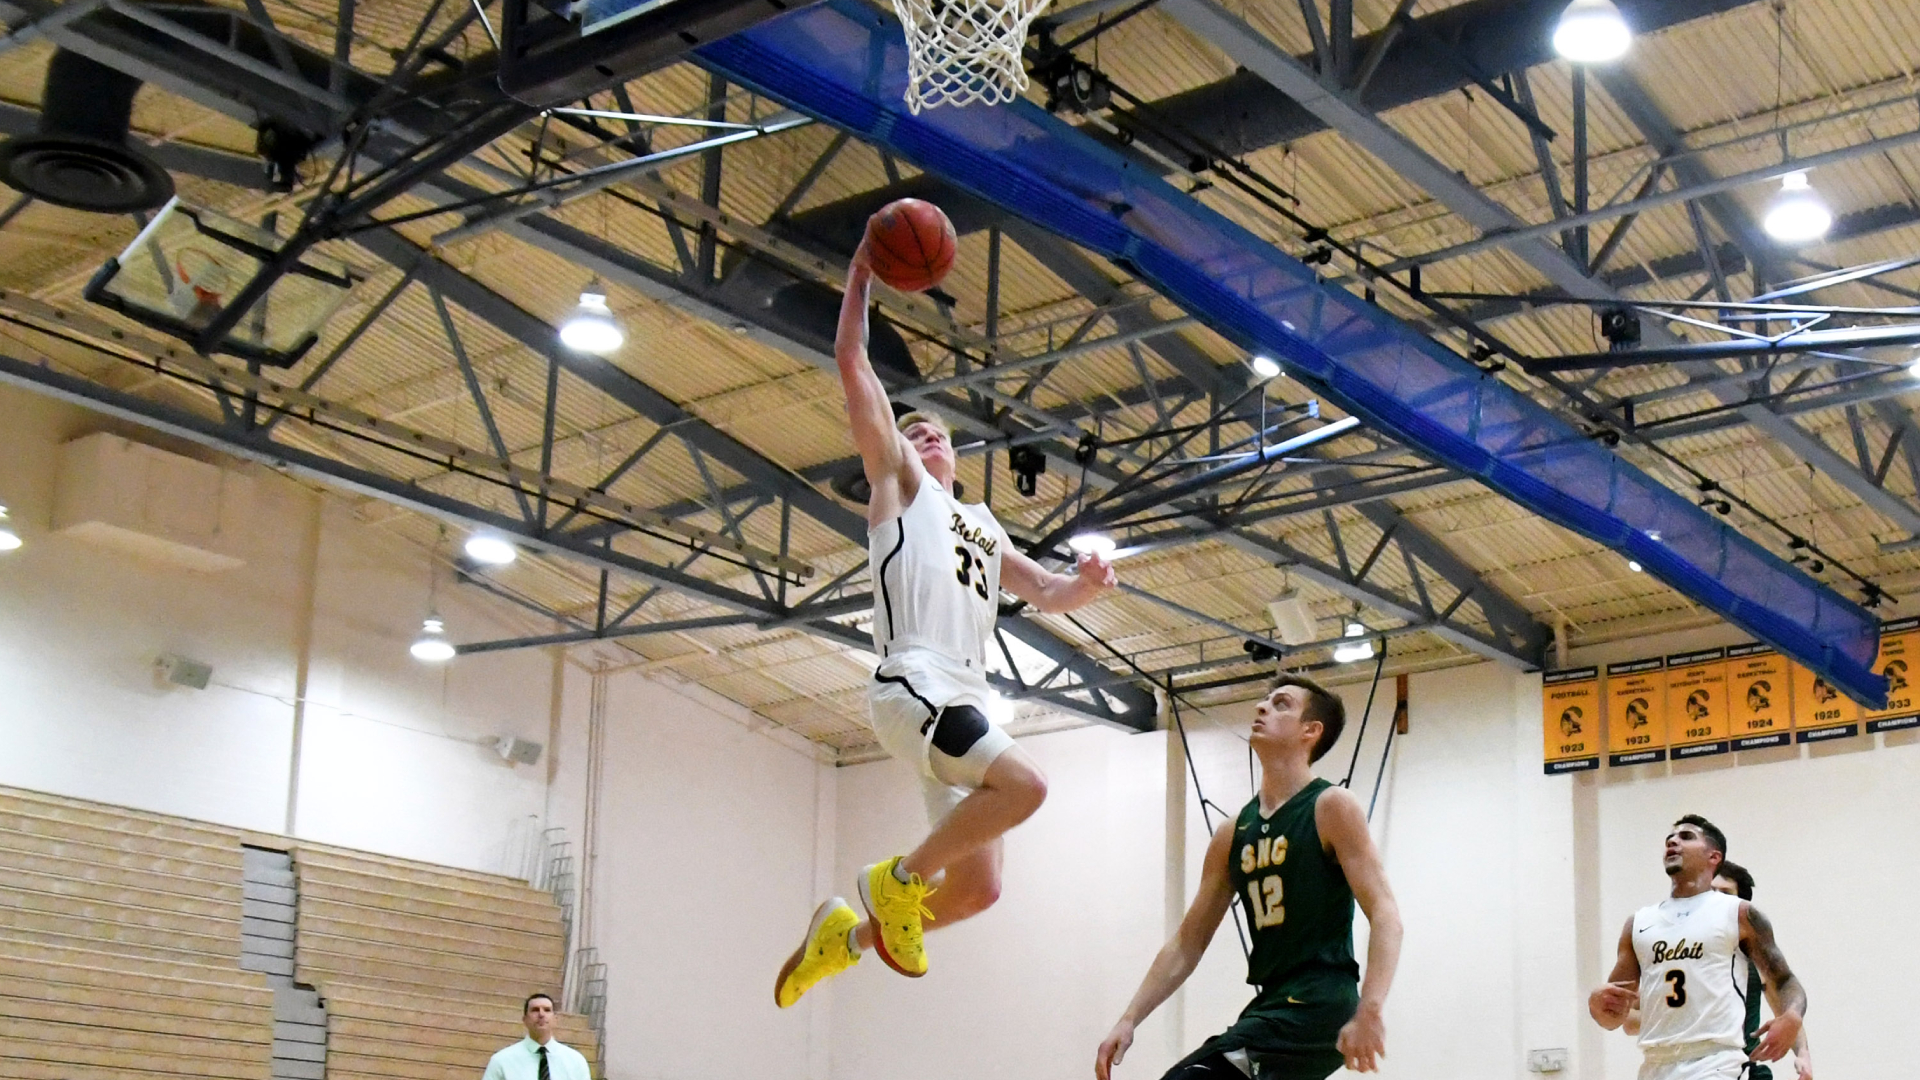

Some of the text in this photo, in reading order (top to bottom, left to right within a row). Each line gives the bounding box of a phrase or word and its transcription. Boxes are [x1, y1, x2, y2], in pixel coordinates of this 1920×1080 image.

[949, 513, 997, 557] Beloit
[955, 545, 989, 601] 33
[1551, 690, 1590, 700] FOOTBALL
[1888, 698, 1911, 710] 933
[1814, 709, 1841, 721] 1925
[1747, 718, 1773, 729] 1924
[1877, 716, 1918, 729] CHAMPIONS
[1685, 726, 1712, 738] 1923
[1807, 727, 1847, 739] CHAMPIONS
[1625, 735, 1651, 746] 1923
[1740, 736, 1780, 747] CHAMPIONS
[1559, 742, 1585, 754] 1923
[1680, 744, 1718, 756] CHAMPIONS
[1619, 752, 1656, 763] CHAMPIONS
[1553, 760, 1590, 771] CHAMPIONS
[1240, 834, 1289, 874] SNC
[1247, 874, 1286, 931] 12
[1652, 938, 1704, 964] Beloit
[1664, 969, 1687, 1008] 3
